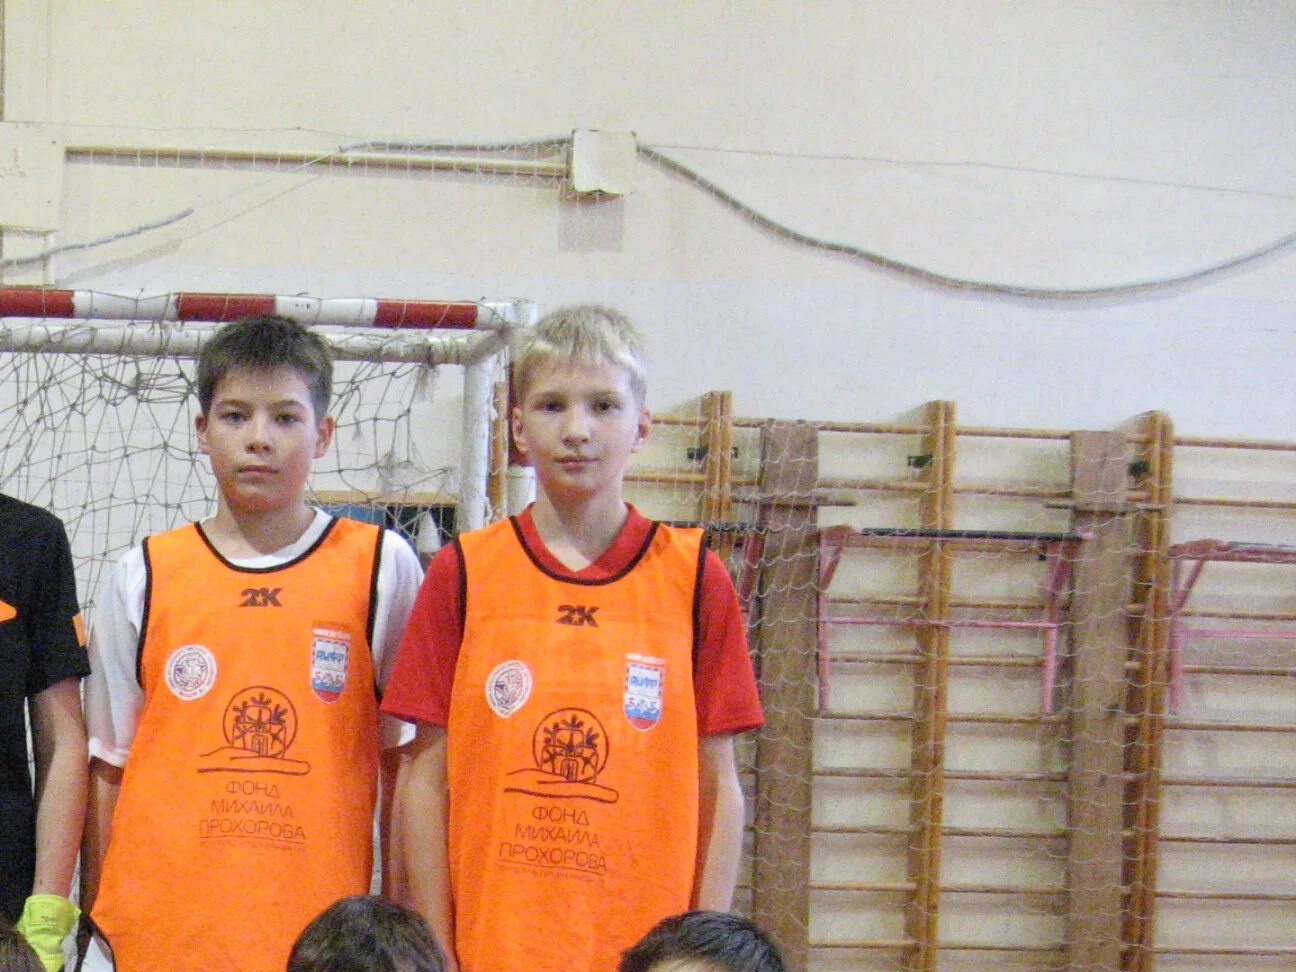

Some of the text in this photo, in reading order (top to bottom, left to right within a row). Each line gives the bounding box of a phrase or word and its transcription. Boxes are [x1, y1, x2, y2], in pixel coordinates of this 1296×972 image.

[226, 780, 280, 799] ФОНД
[210, 799, 295, 818] МИХАИЛА
[532, 806, 589, 826] ФОНД
[199, 819, 306, 840] ПРОХОРОВА
[515, 823, 600, 848] МИХАИЛА
[498, 842, 607, 871] ПРОХОРОВА
